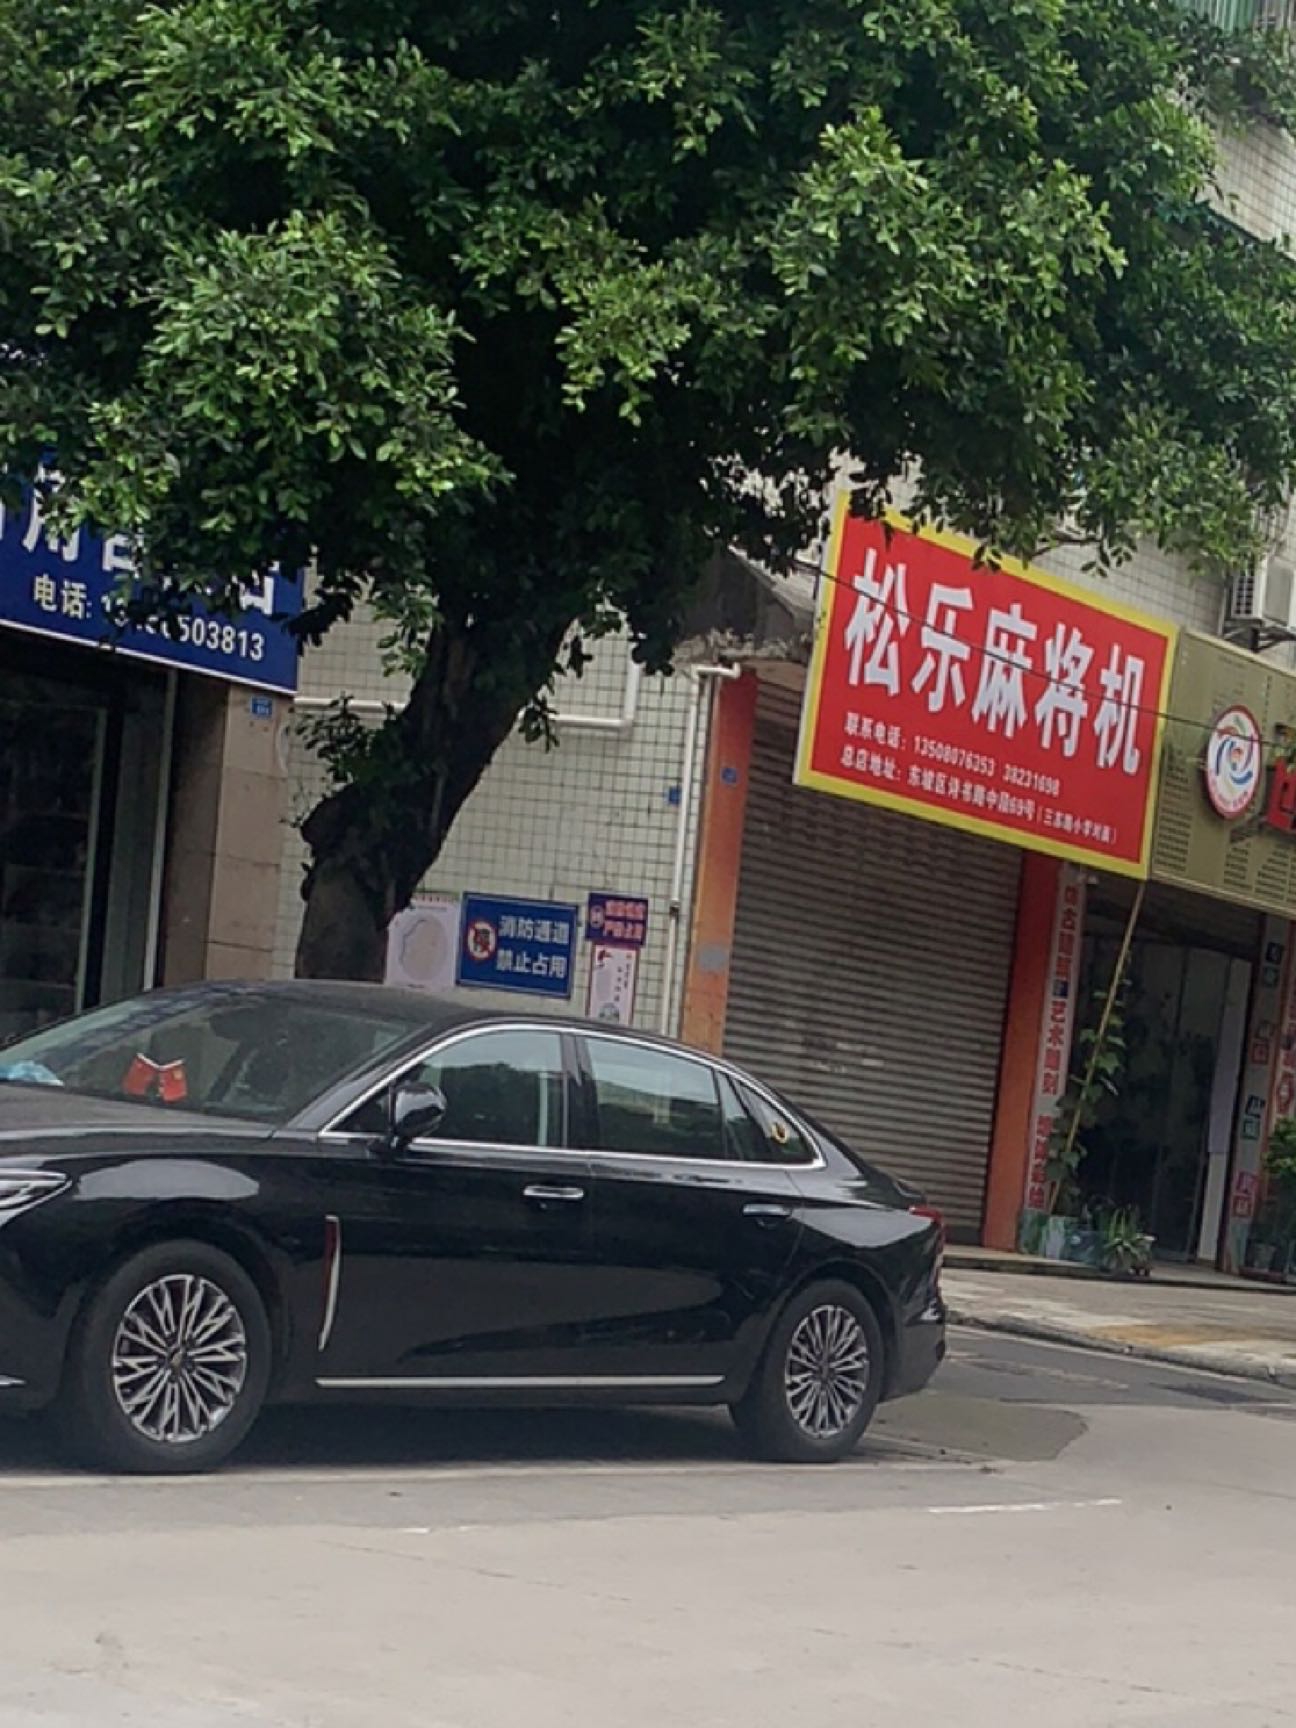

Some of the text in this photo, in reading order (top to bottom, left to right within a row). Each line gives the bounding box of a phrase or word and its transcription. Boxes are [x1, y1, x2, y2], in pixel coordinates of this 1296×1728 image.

[844, 547, 1145, 774] 松乐麻将机
[499, 915, 569, 944] 消防通道
[496, 950, 568, 979] 禁止占用
